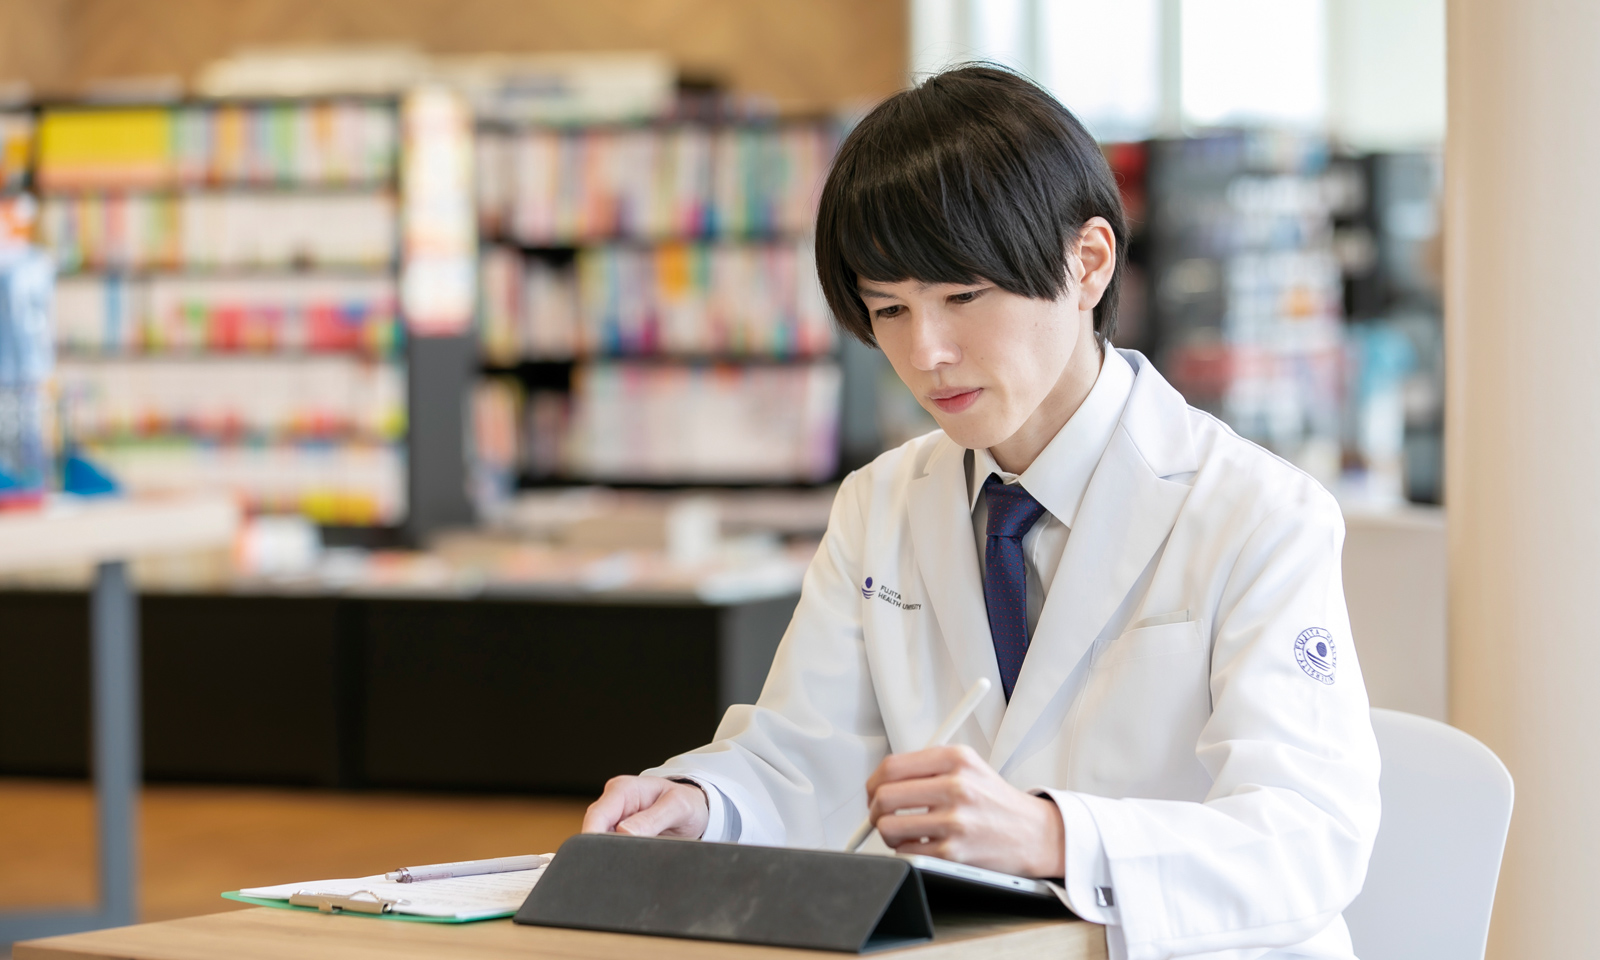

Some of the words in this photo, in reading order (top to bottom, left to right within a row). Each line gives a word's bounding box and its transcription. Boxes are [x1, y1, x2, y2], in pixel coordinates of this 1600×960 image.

[878, 592, 902, 607] HEALTH
[880, 585, 901, 600] FUJITA
[1295, 629, 1320, 652] FUJITA
